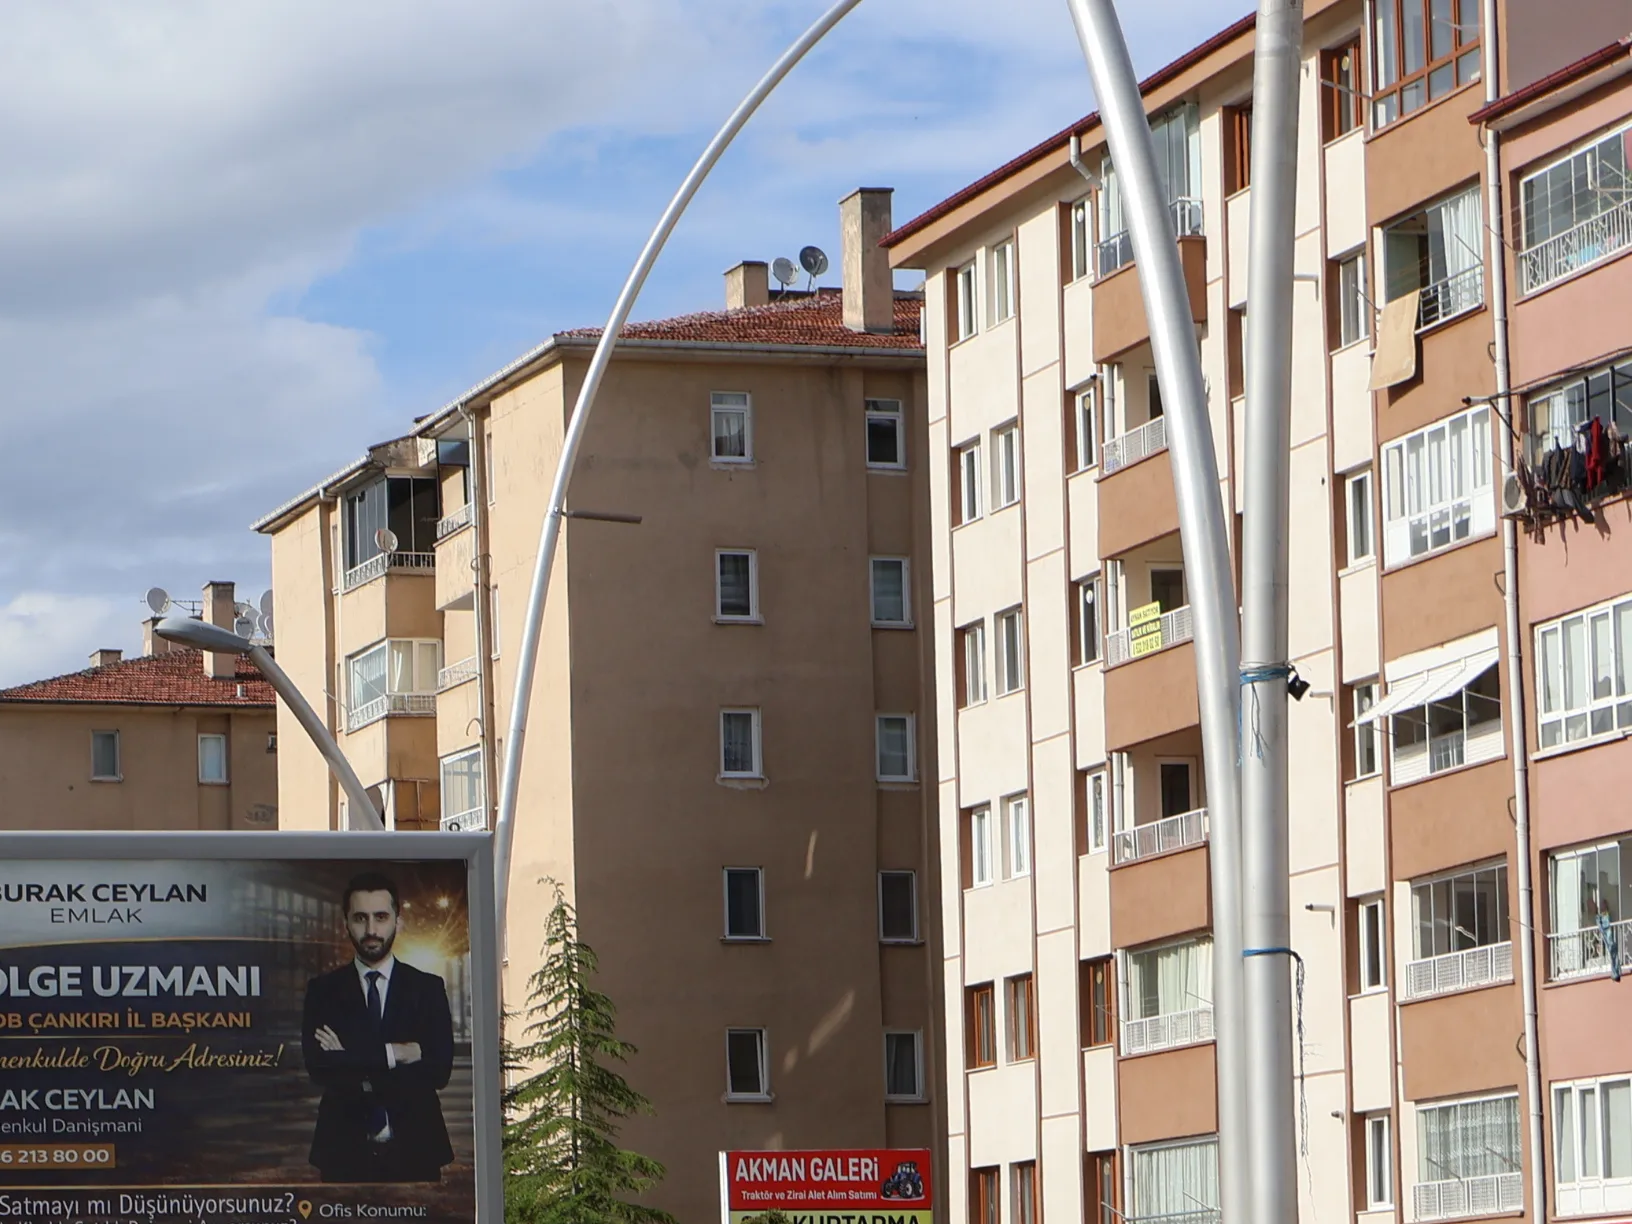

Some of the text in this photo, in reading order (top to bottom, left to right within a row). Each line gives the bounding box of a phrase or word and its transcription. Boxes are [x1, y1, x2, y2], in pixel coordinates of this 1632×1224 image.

[92, 883, 207, 902] CEYLAN
[50, 907, 143, 923] EMLAK
[92, 965, 261, 997] UZMANI
[28, 1012, 120, 1034] ÇANKIRI
[126, 1007, 146, 1029] İL
[151, 1011, 251, 1033] BAŞKANI
[92, 1045, 167, 1077] Doğru
[164, 1043, 284, 1073] Adresiniz!
[44, 1088, 155, 1110] CEYLAN
[17, 1149, 48, 1164] 213
[53, 1149, 78, 1163] 80
[82, 1149, 110, 1163] 00
[735, 1157, 805, 1181] AKMAN
[87, 1199, 112, 1215] mı
[119, 1193, 294, 1219] Düşünüyorsunuz?
[741, 1190, 773, 1200] Traktör
[808, 1190, 825, 1199] Alet
[319, 1203, 427, 1217] Ofis Konumu:
